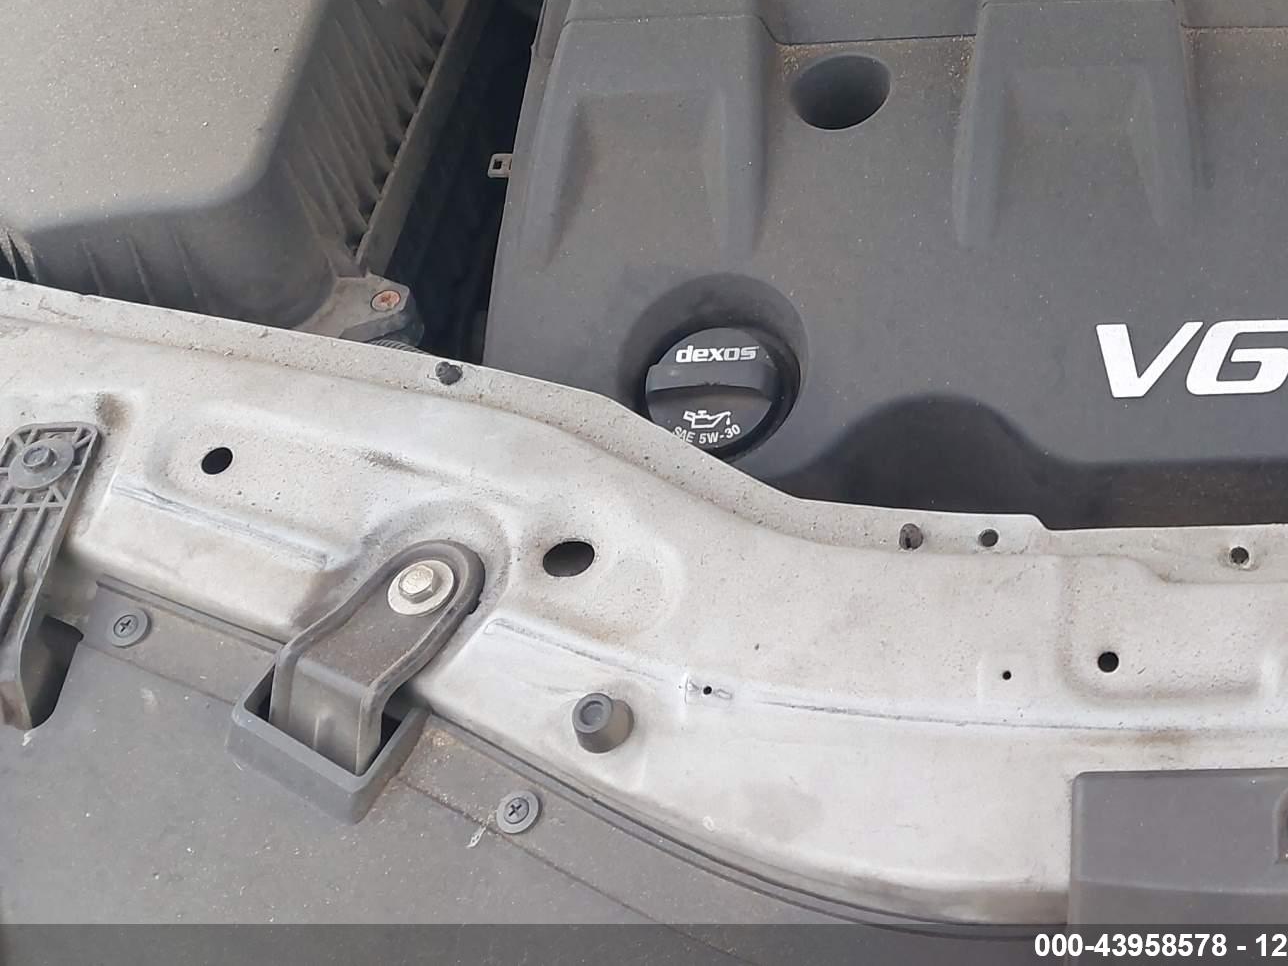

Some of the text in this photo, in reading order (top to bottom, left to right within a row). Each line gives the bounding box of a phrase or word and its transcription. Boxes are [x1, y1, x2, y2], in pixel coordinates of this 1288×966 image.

[675, 344, 760, 363] dexos
[673, 424, 741, 444] SAE 5W-30
